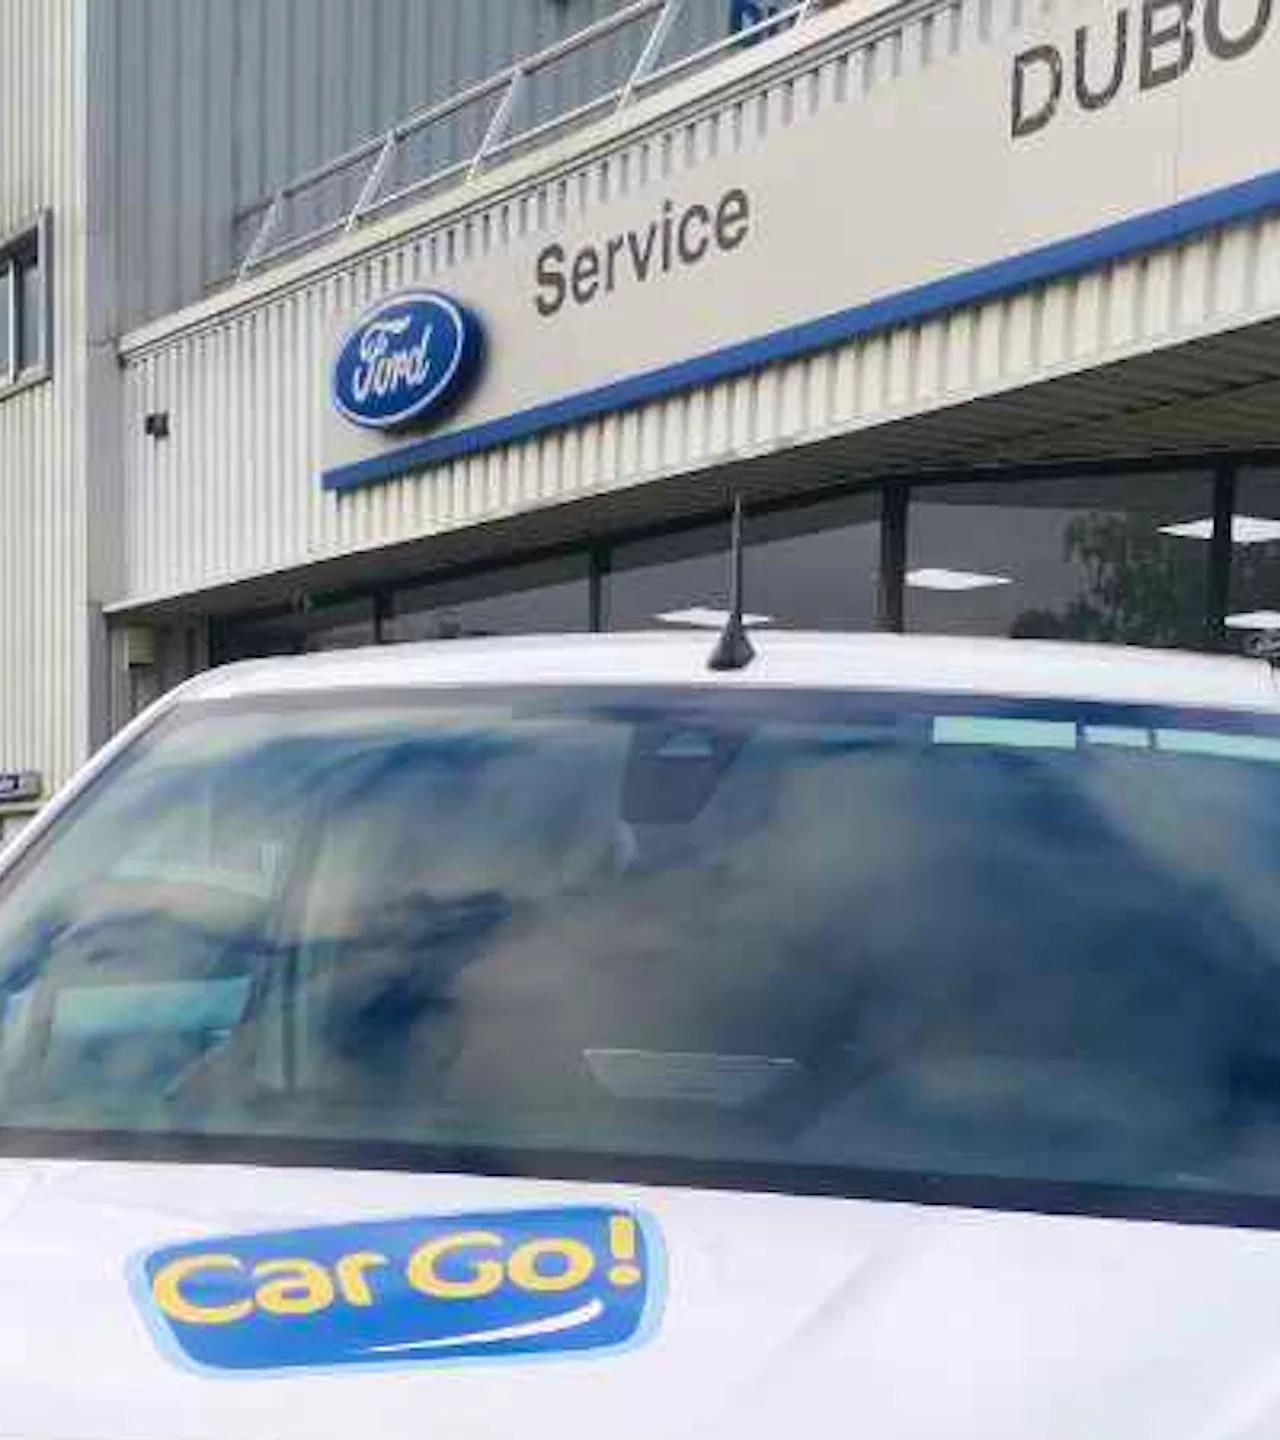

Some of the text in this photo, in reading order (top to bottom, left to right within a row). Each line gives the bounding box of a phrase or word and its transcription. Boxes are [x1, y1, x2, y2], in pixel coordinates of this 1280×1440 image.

[533, 186, 751, 318] Service
[351, 314, 434, 403] Ford
[151, 1212, 641, 1326] Car Go!
